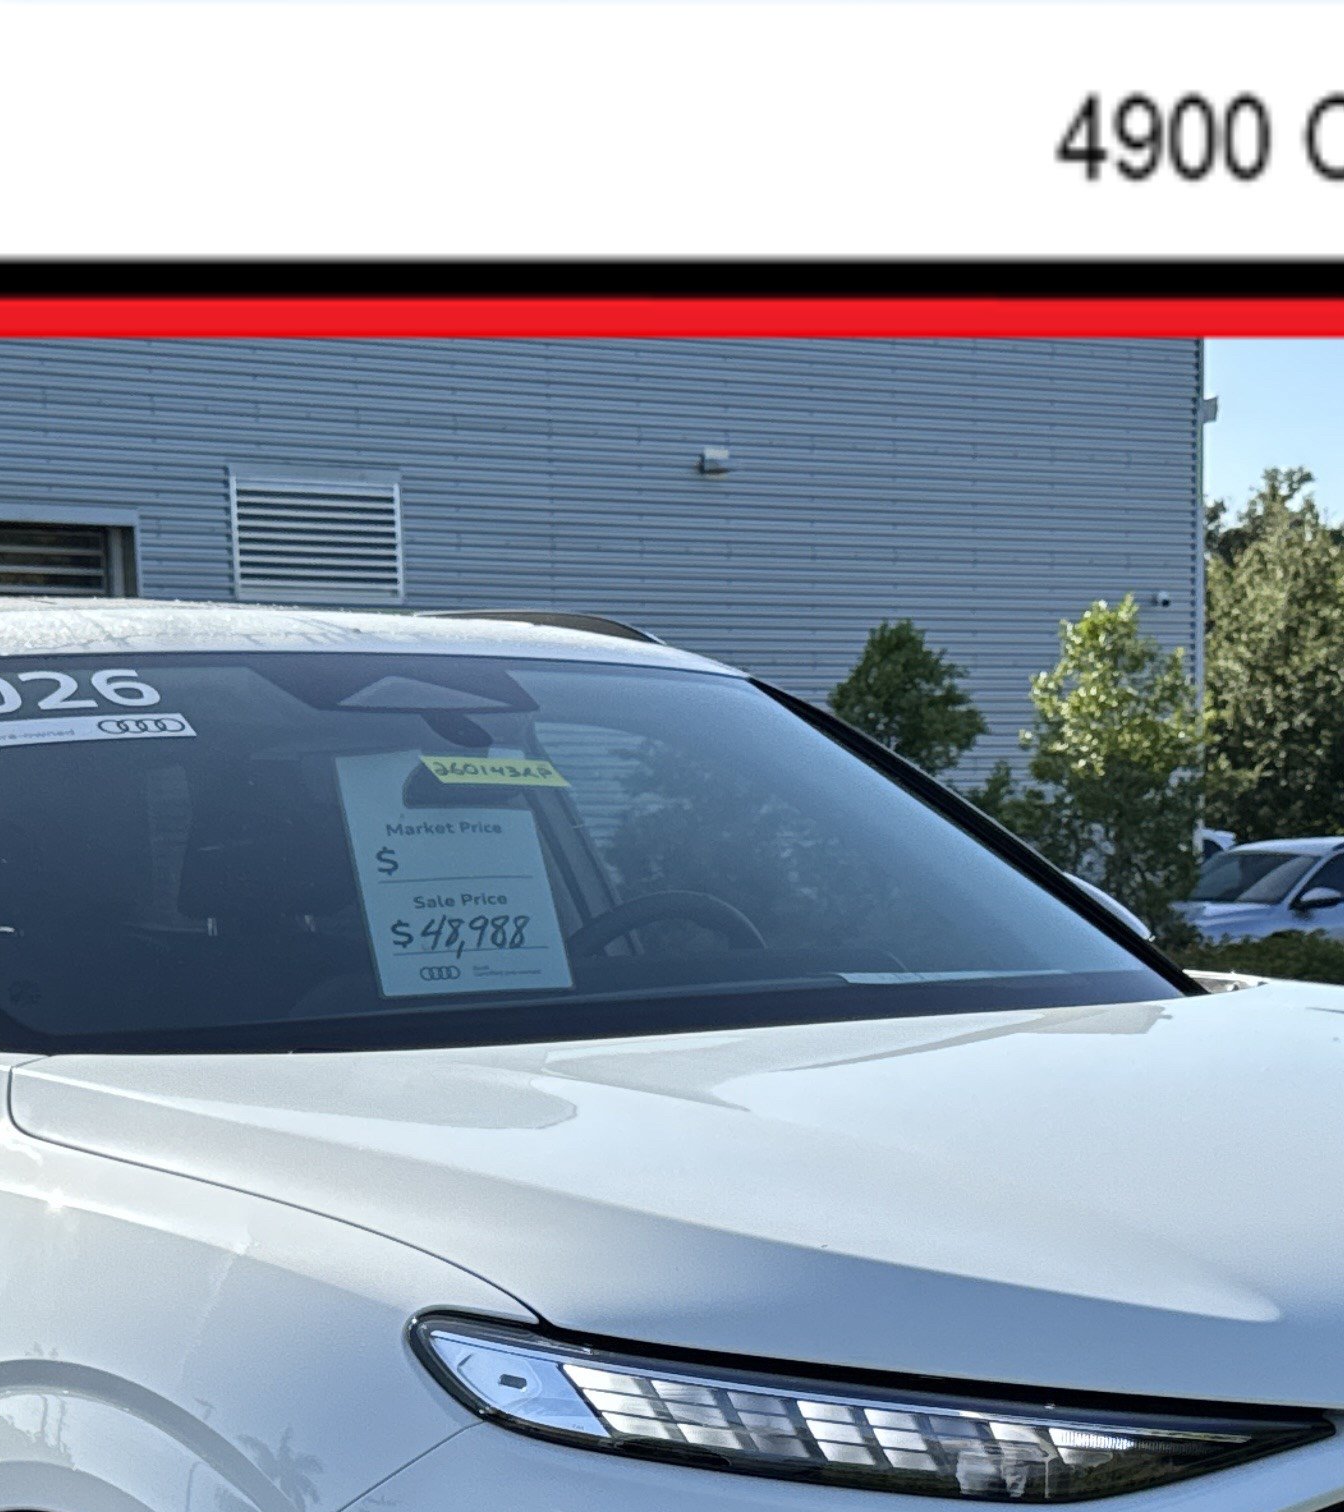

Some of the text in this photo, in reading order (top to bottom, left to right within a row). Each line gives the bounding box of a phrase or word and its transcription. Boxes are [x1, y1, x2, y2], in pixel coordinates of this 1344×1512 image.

[386, 822, 502, 837] Market Price
[375, 846, 399, 876] $
[413, 893, 508, 909] Sale Price
